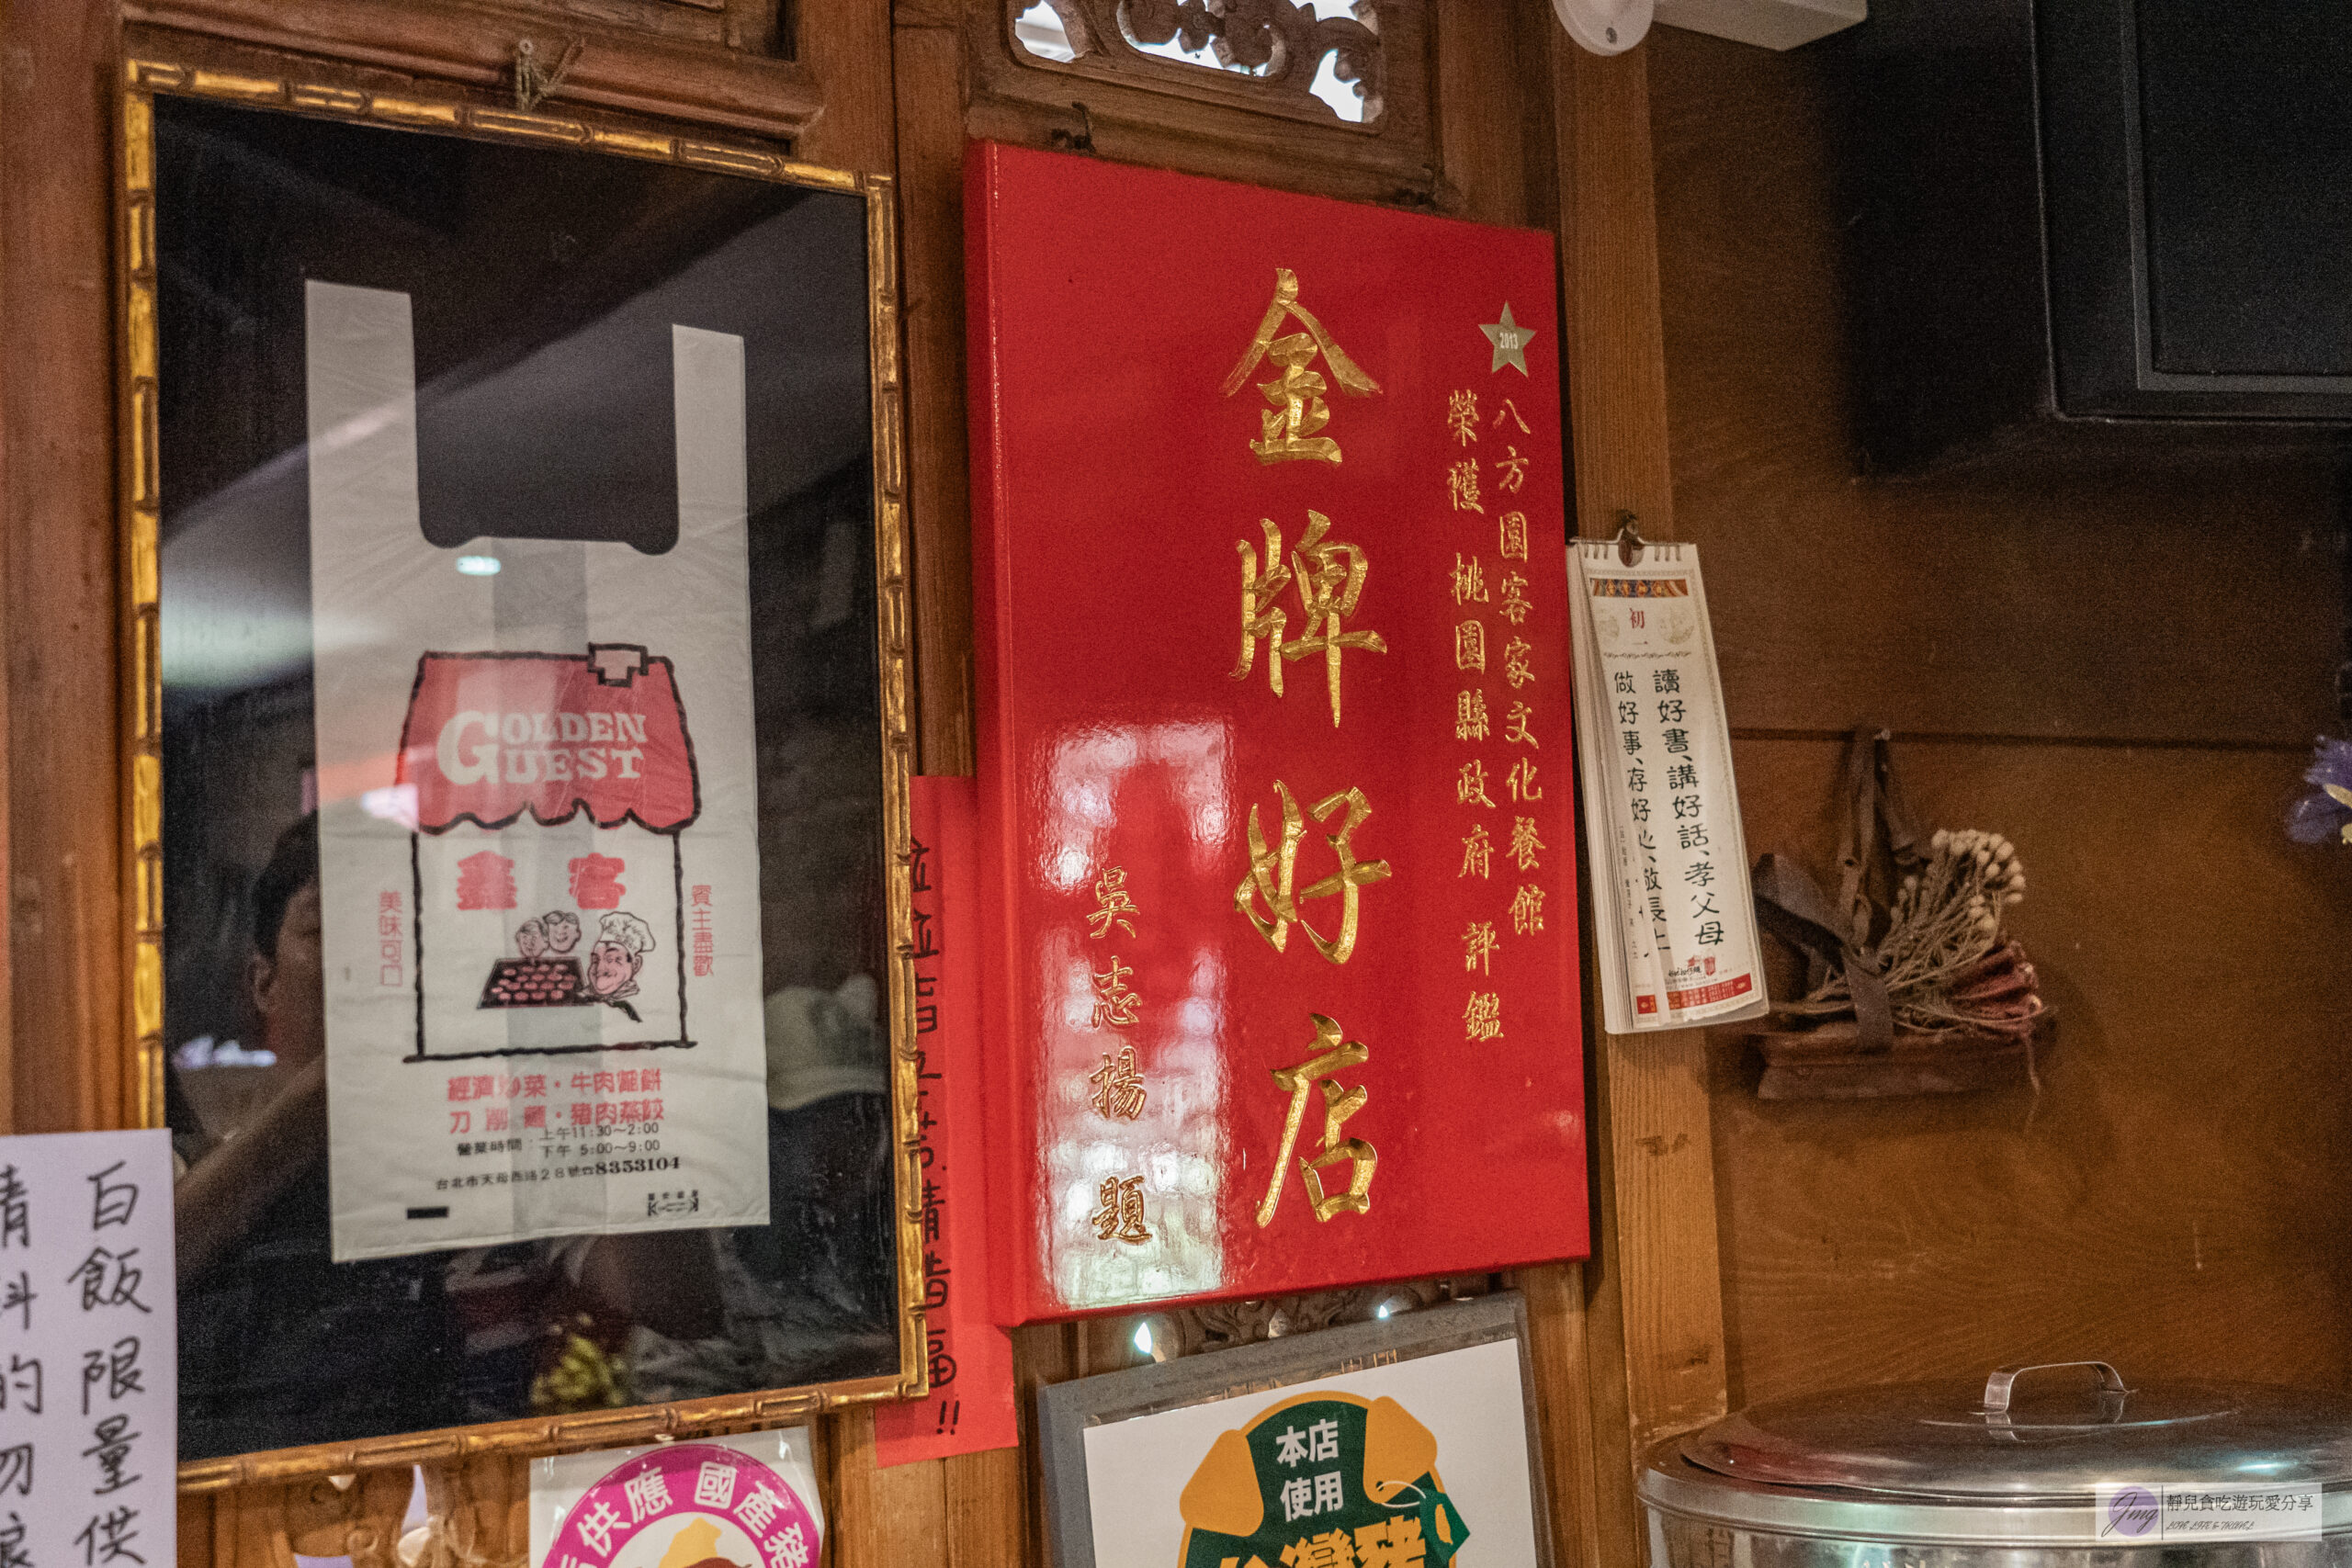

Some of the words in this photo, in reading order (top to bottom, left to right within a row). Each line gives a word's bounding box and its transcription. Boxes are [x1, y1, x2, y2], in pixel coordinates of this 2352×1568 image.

[1498, 332, 1519, 350] 2013
[1629, 607, 1648, 646] 初一
[1492, 399, 1545, 936] 八方園客家文化餐館
[1220, 267, 1392, 1228] 金牌好店
[379, 890, 403, 987] 美味可口
[68, 1159, 153, 1566] 白飯限量供
[1275, 1418, 1340, 1469] 本店
[1280, 1470, 1344, 1522] 使用
